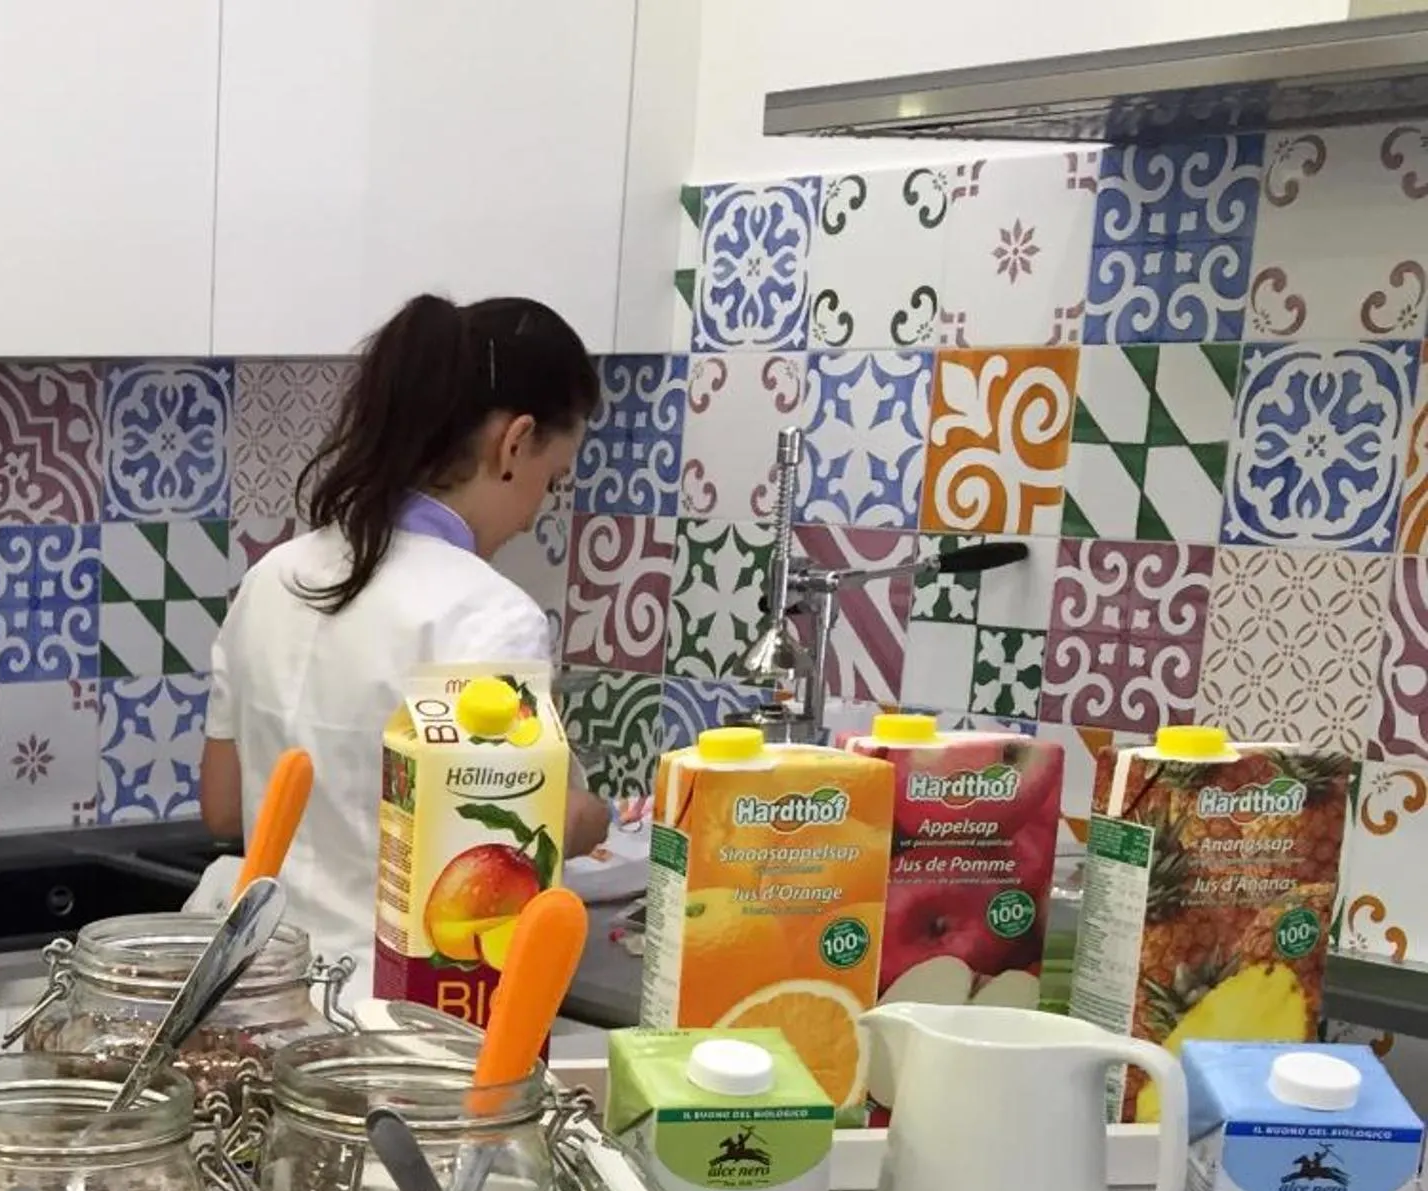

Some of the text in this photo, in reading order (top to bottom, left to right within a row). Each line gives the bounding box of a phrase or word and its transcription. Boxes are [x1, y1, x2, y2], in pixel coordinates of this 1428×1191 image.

[415, 699, 460, 745] BIO
[445, 767, 538, 788] Höllinger
[910, 774, 1017, 799] Hardthof
[736, 797, 848, 825] Hardthof
[1200, 788, 1304, 815] Hardthof
[918, 818, 999, 838] Appelsap
[1200, 837, 1294, 854] Ananassap
[895, 856, 1017, 873] Jus de Pomme
[1193, 877, 1220, 893] Jus
[437, 980, 490, 1026] BI
[1308, 1128, 1328, 1137] DEL
